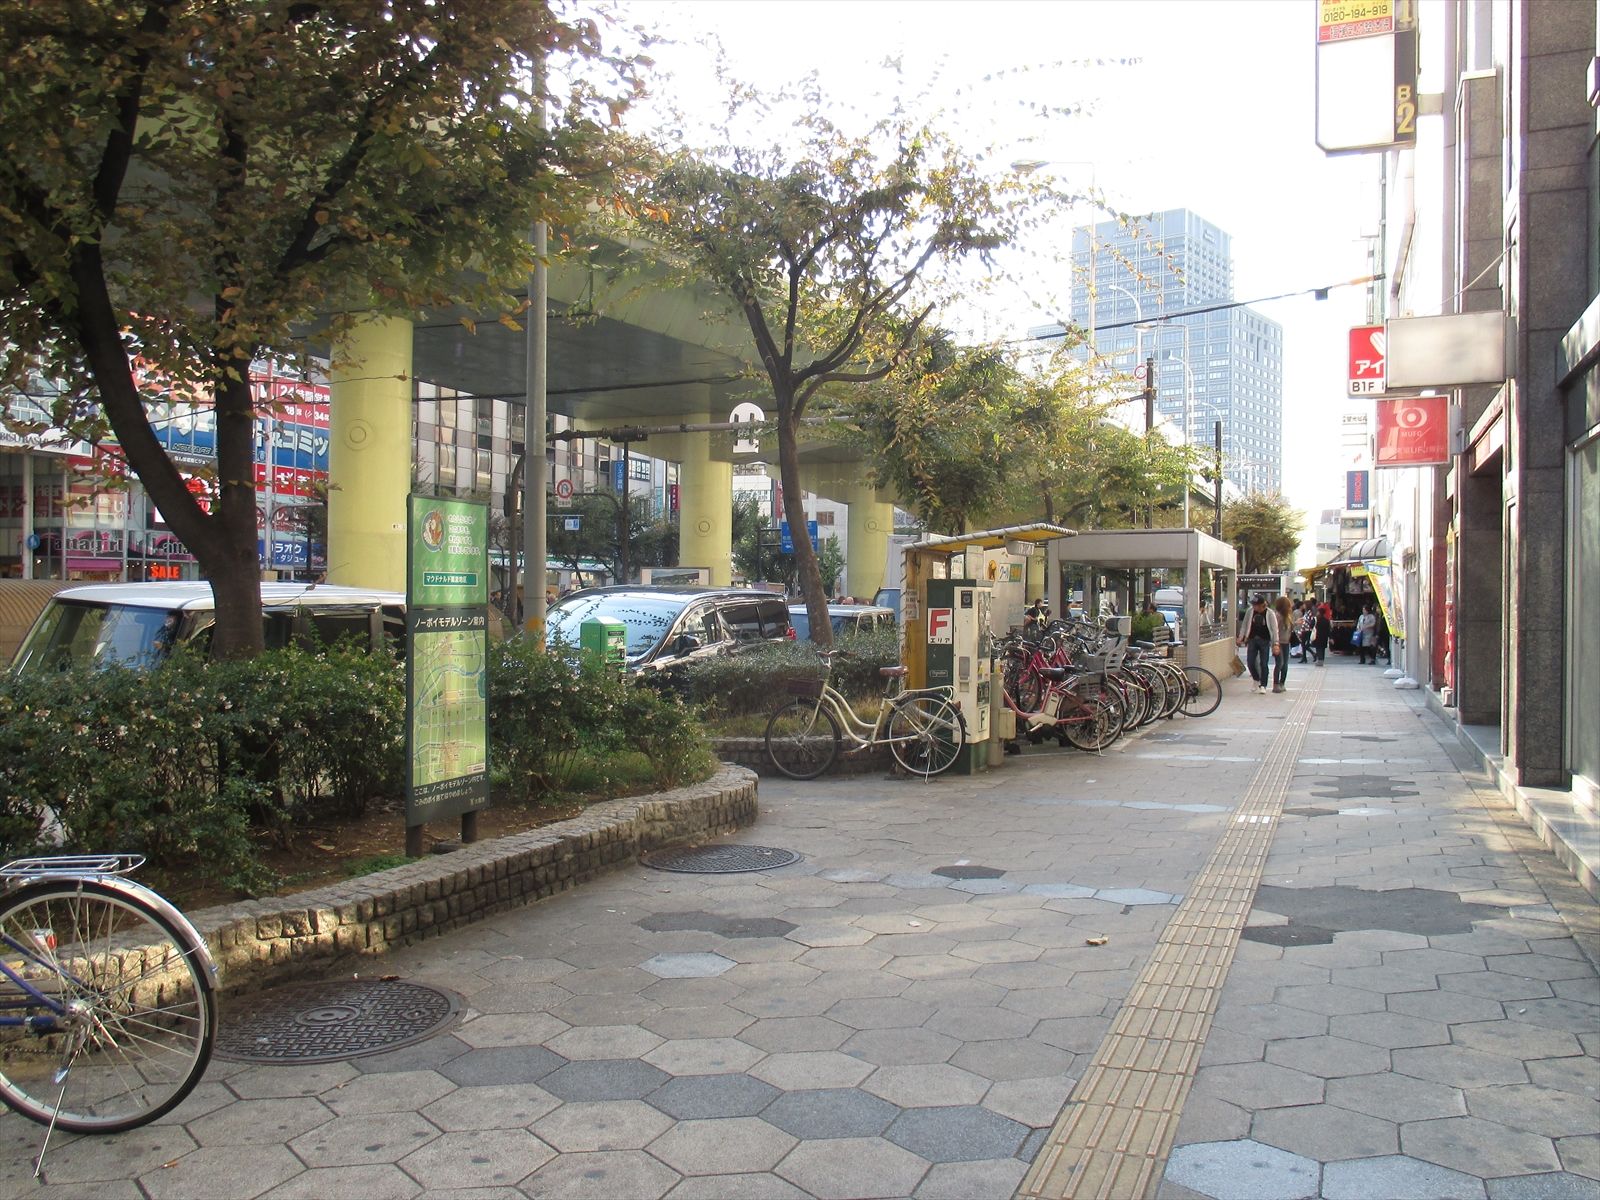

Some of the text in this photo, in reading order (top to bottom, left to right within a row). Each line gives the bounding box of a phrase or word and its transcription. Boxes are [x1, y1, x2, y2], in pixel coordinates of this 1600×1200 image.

[1352, 381, 1375, 392] B1F
[151, 565, 180, 578] SALE
[930, 609, 951, 636] F
